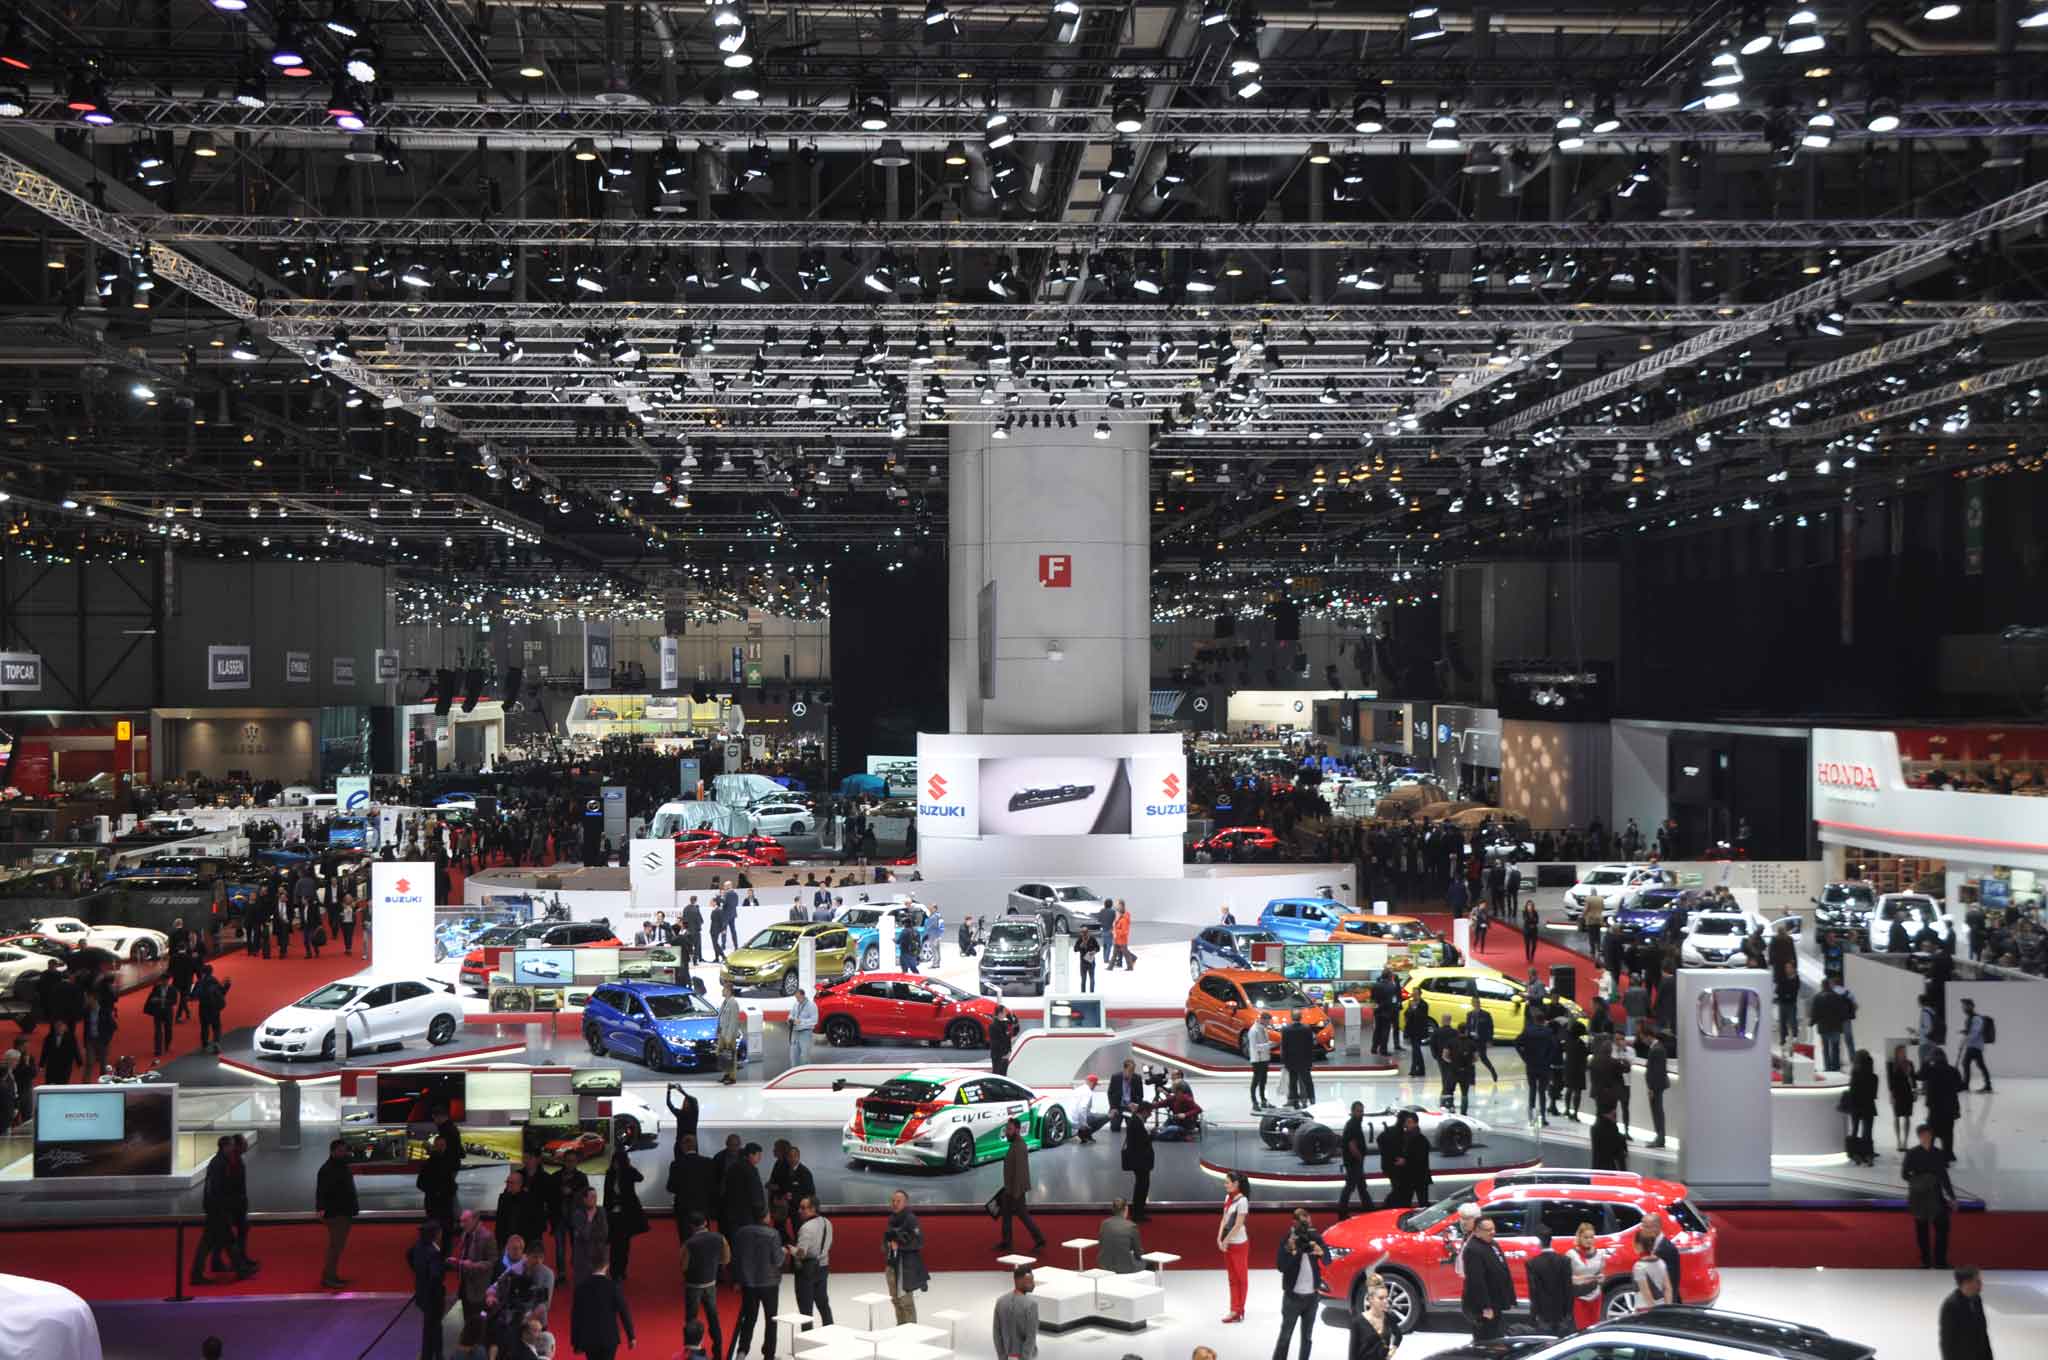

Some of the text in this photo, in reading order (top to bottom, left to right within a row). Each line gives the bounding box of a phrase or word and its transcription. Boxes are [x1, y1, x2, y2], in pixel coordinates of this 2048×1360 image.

[1048, 557, 1065, 580] F
[6, 664, 34, 680] TOPCAR
[1817, 763, 1878, 791] HONDA
[919, 804, 965, 816] SUZUKI
[951, 1110, 992, 1124] CIVIC
[859, 1144, 897, 1156] HONDA
